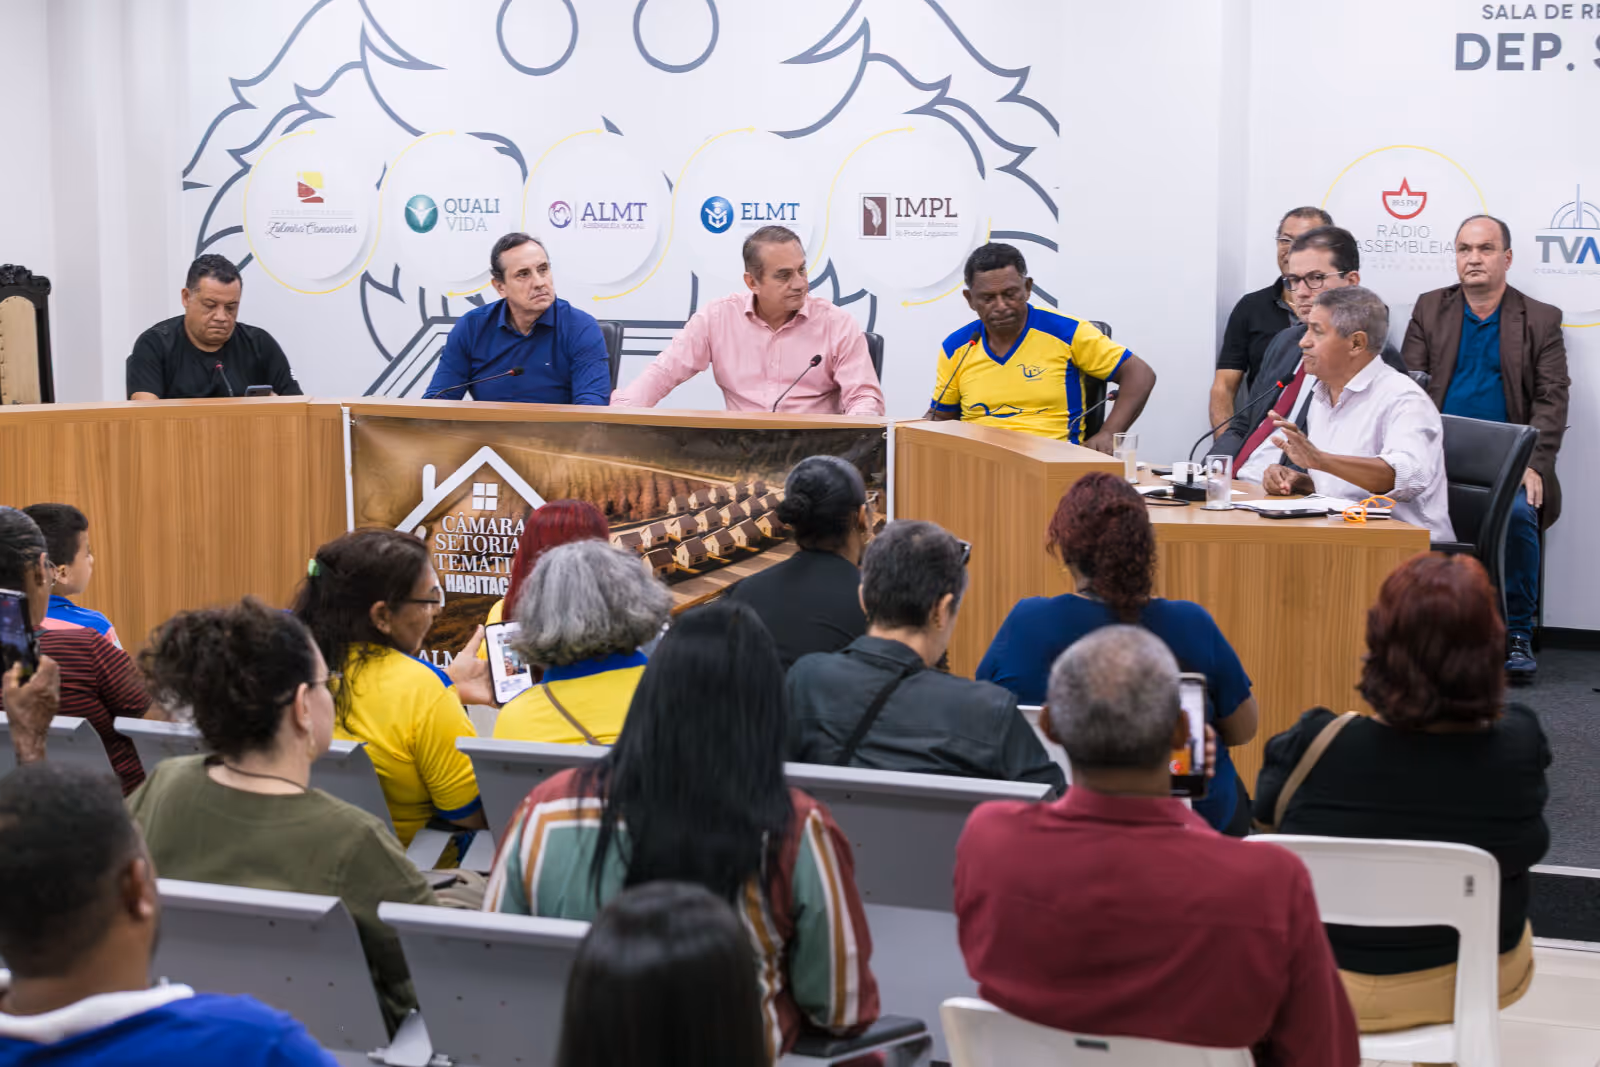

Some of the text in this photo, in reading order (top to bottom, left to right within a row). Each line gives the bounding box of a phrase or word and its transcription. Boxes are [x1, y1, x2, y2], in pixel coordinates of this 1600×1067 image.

[1481, 4, 1537, 20] SALA
[1544, 4, 1573, 20] DE
[1455, 32, 1575, 72] DEP.
[444, 198, 501, 215] QUALI
[580, 201, 648, 222] ALMT
[740, 202, 800, 221] ELMT
[895, 197, 958, 218] IMPL
[445, 216, 488, 232] VIDA
[1376, 221, 1431, 238] RÁDIO
[442, 511, 525, 536] CÂMARA
[434, 533, 520, 554] SETORIA
[433, 551, 512, 574] TEMÁTI
